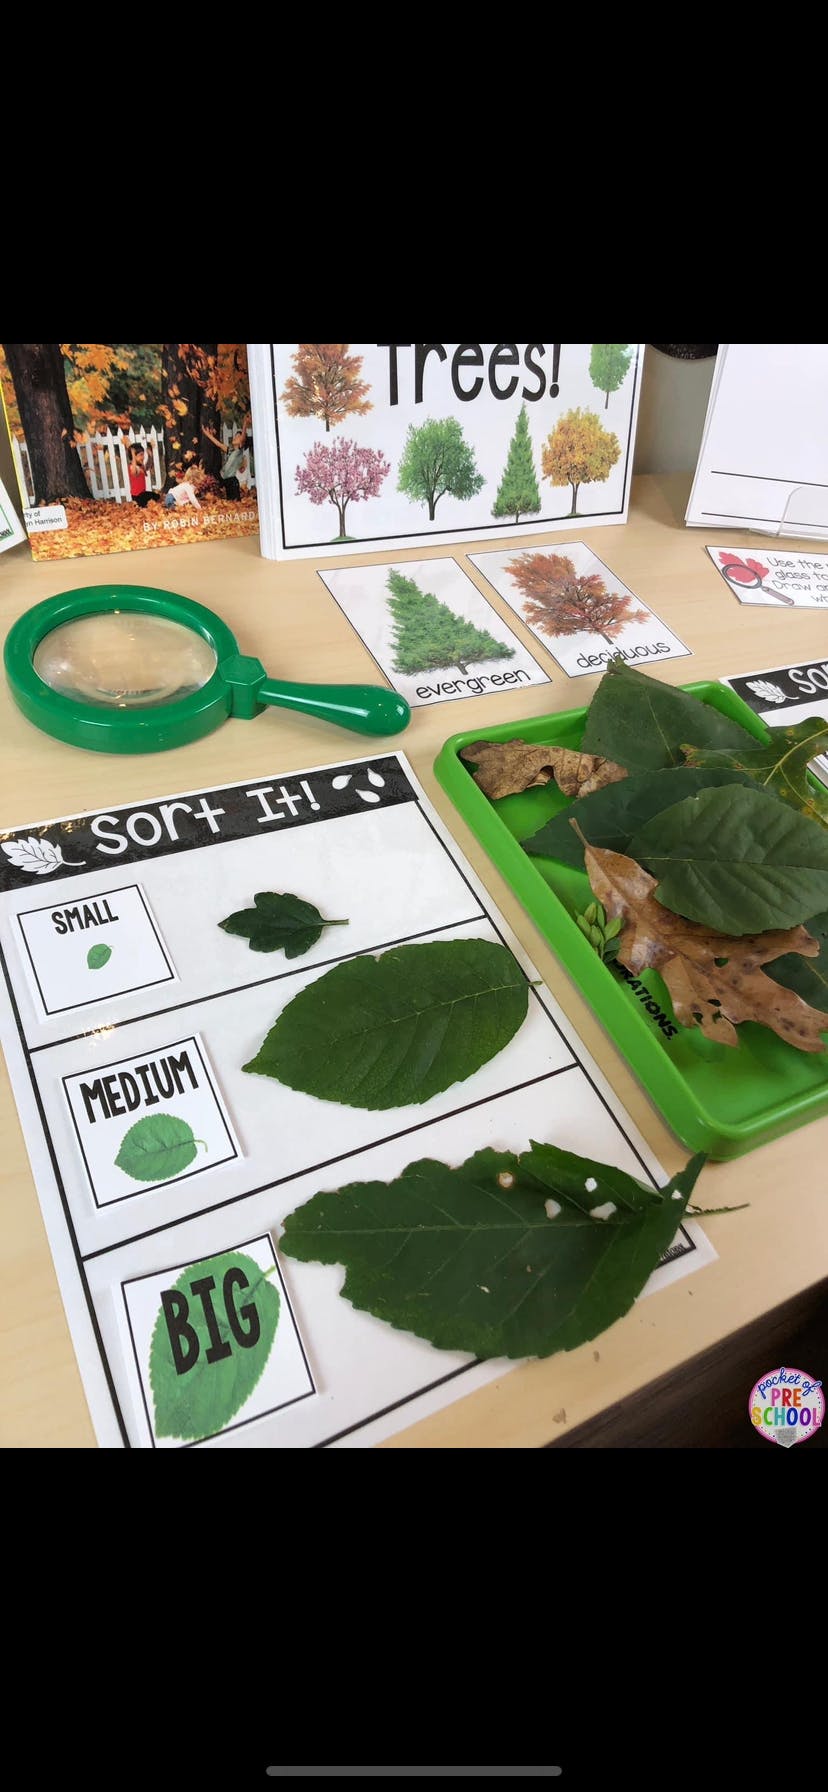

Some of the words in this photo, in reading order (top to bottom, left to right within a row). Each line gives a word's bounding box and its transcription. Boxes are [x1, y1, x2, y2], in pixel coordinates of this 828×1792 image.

[377, 344, 561, 406] Trees!
[34, 517, 63, 526] Harrison
[143, 521, 157, 532] BY
[163, 517, 199, 530] ROBIN
[203, 511, 255, 525] BERNARD
[766, 557, 795, 568] Use
[797, 559, 824, 570] the
[775, 569, 811, 580] glass
[813, 571, 828, 580] to
[772, 579, 811, 591] Draw
[576, 642, 671, 669] deciduous
[416, 667, 531, 699] evergreen
[90, 799, 227, 856] Sort
[245, 780, 321, 824] It!
[51, 899, 119, 935] SMALL
[611, 958, 678, 1040] RATIONS.
[79, 1050, 199, 1124] MEDIUM
[160, 1267, 262, 1376] BIG
